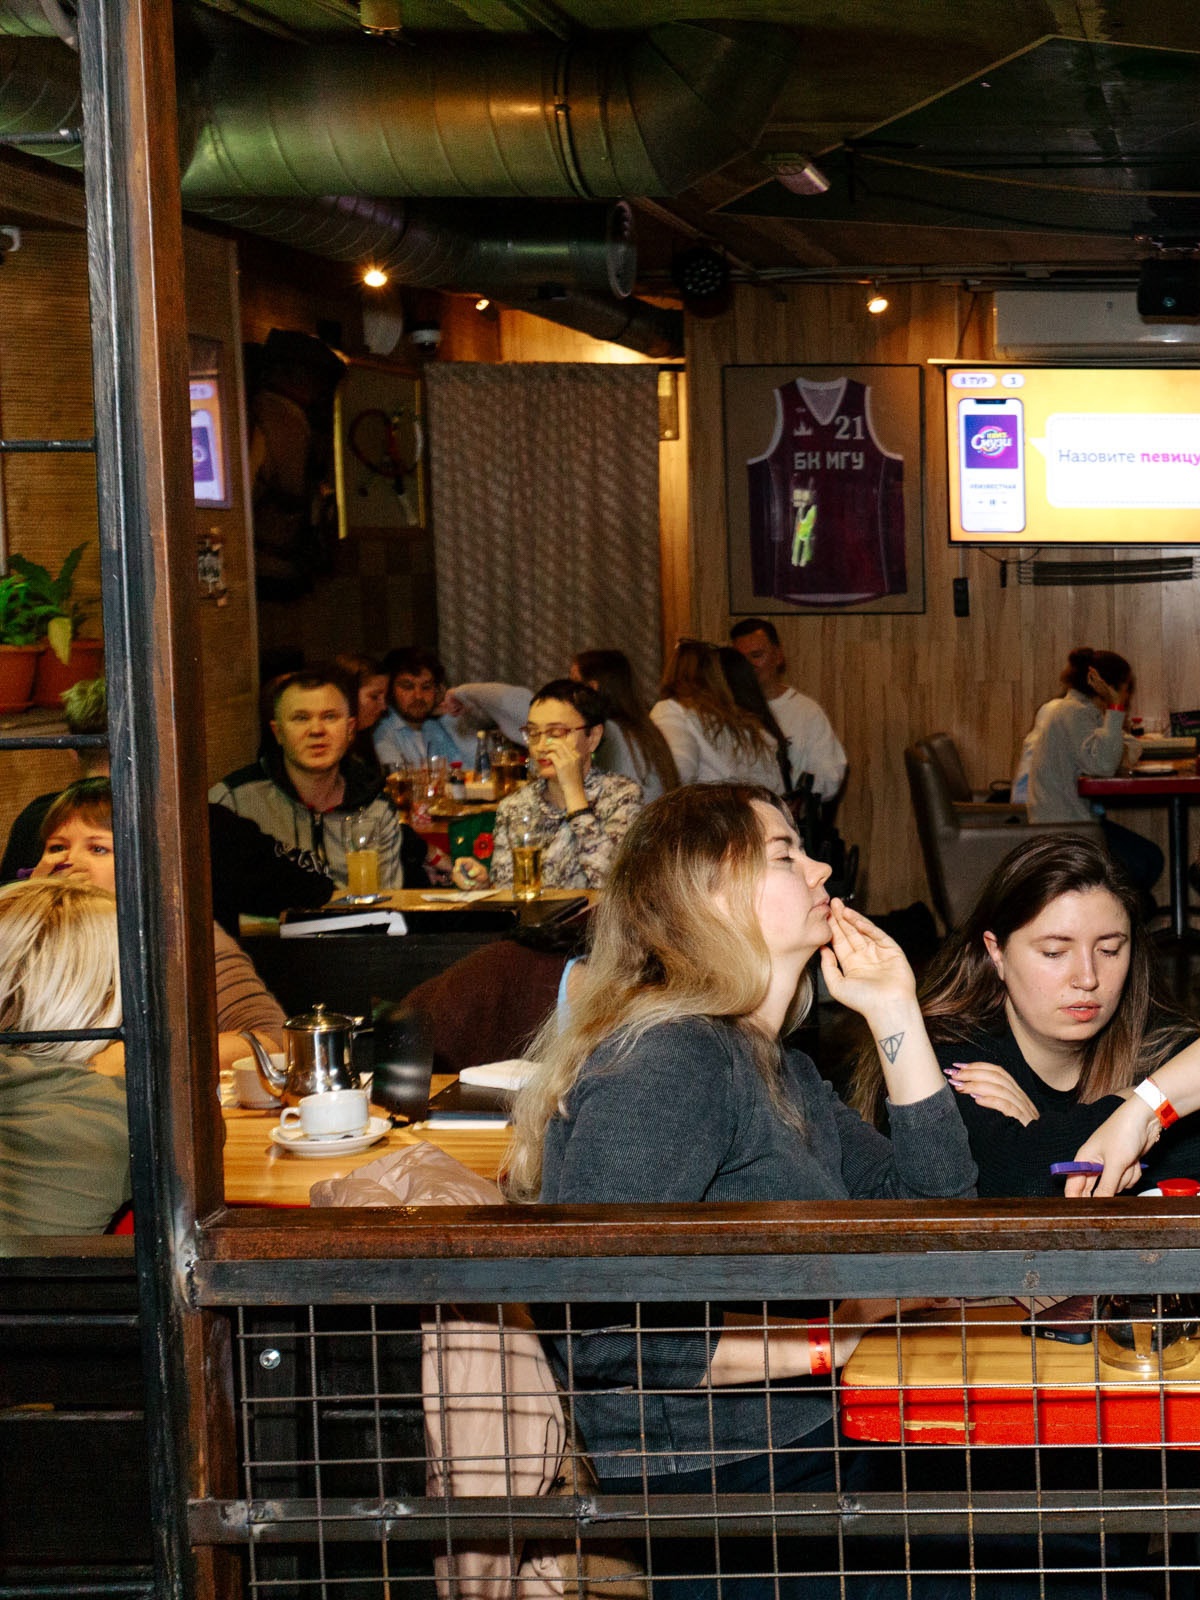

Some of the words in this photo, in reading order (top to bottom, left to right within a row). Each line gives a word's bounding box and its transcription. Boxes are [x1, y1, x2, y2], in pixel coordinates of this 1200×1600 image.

[834, 415, 865, 440] 21
[825, 451, 865, 470] МГУ
[1058, 449, 1135, 463] Назовите
